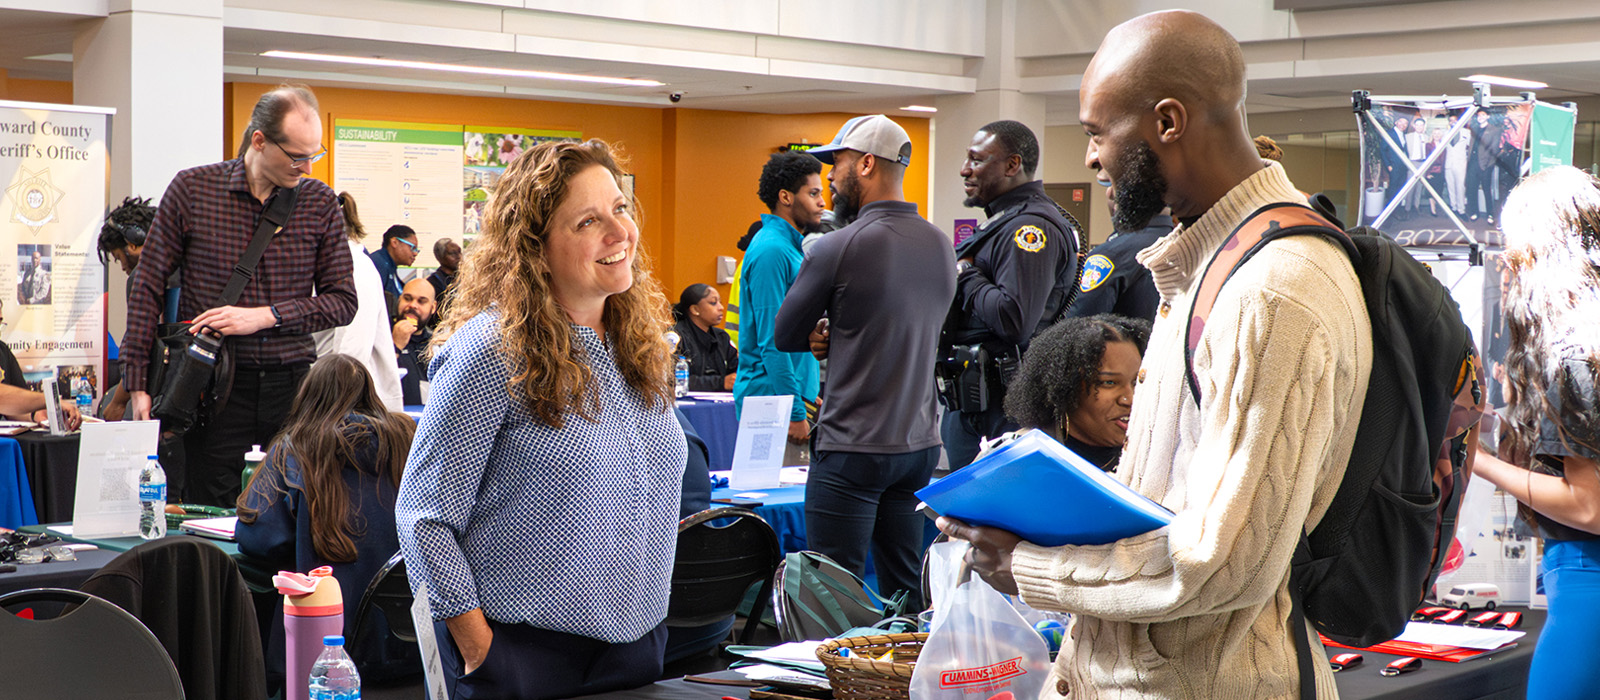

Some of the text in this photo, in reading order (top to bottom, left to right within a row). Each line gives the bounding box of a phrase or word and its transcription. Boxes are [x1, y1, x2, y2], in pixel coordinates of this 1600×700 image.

[0, 121, 92, 141] ward County
[338, 128, 398, 141] SUSTAINABILITY
[0, 143, 89, 161] eriff's Office
[35, 340, 93, 351] Engagement
